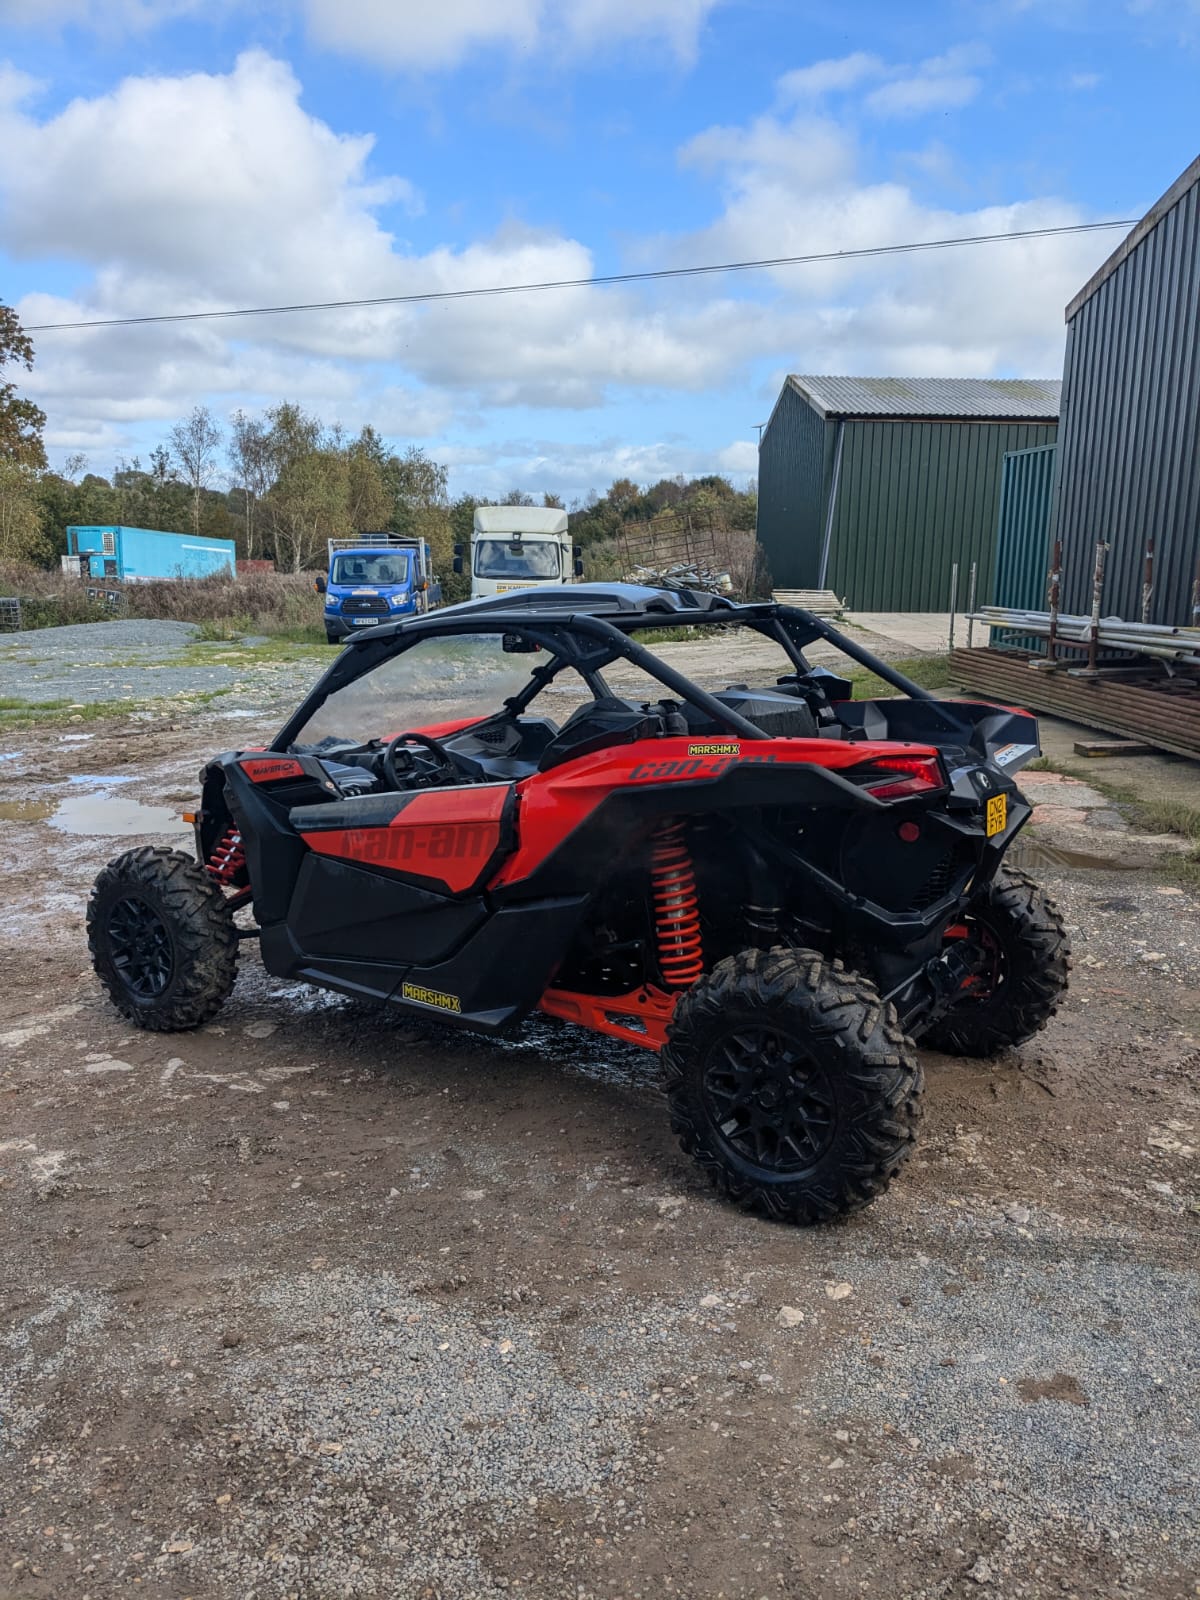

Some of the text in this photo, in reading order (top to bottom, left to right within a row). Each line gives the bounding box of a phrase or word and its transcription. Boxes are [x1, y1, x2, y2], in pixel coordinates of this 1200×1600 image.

[689, 745, 739, 755] MARSHMX
[252, 762, 295, 775] MAVERICK
[989, 814, 1004, 834] FYR
[340, 825, 498, 860] can-am
[403, 984, 460, 1011] MARSHMX
